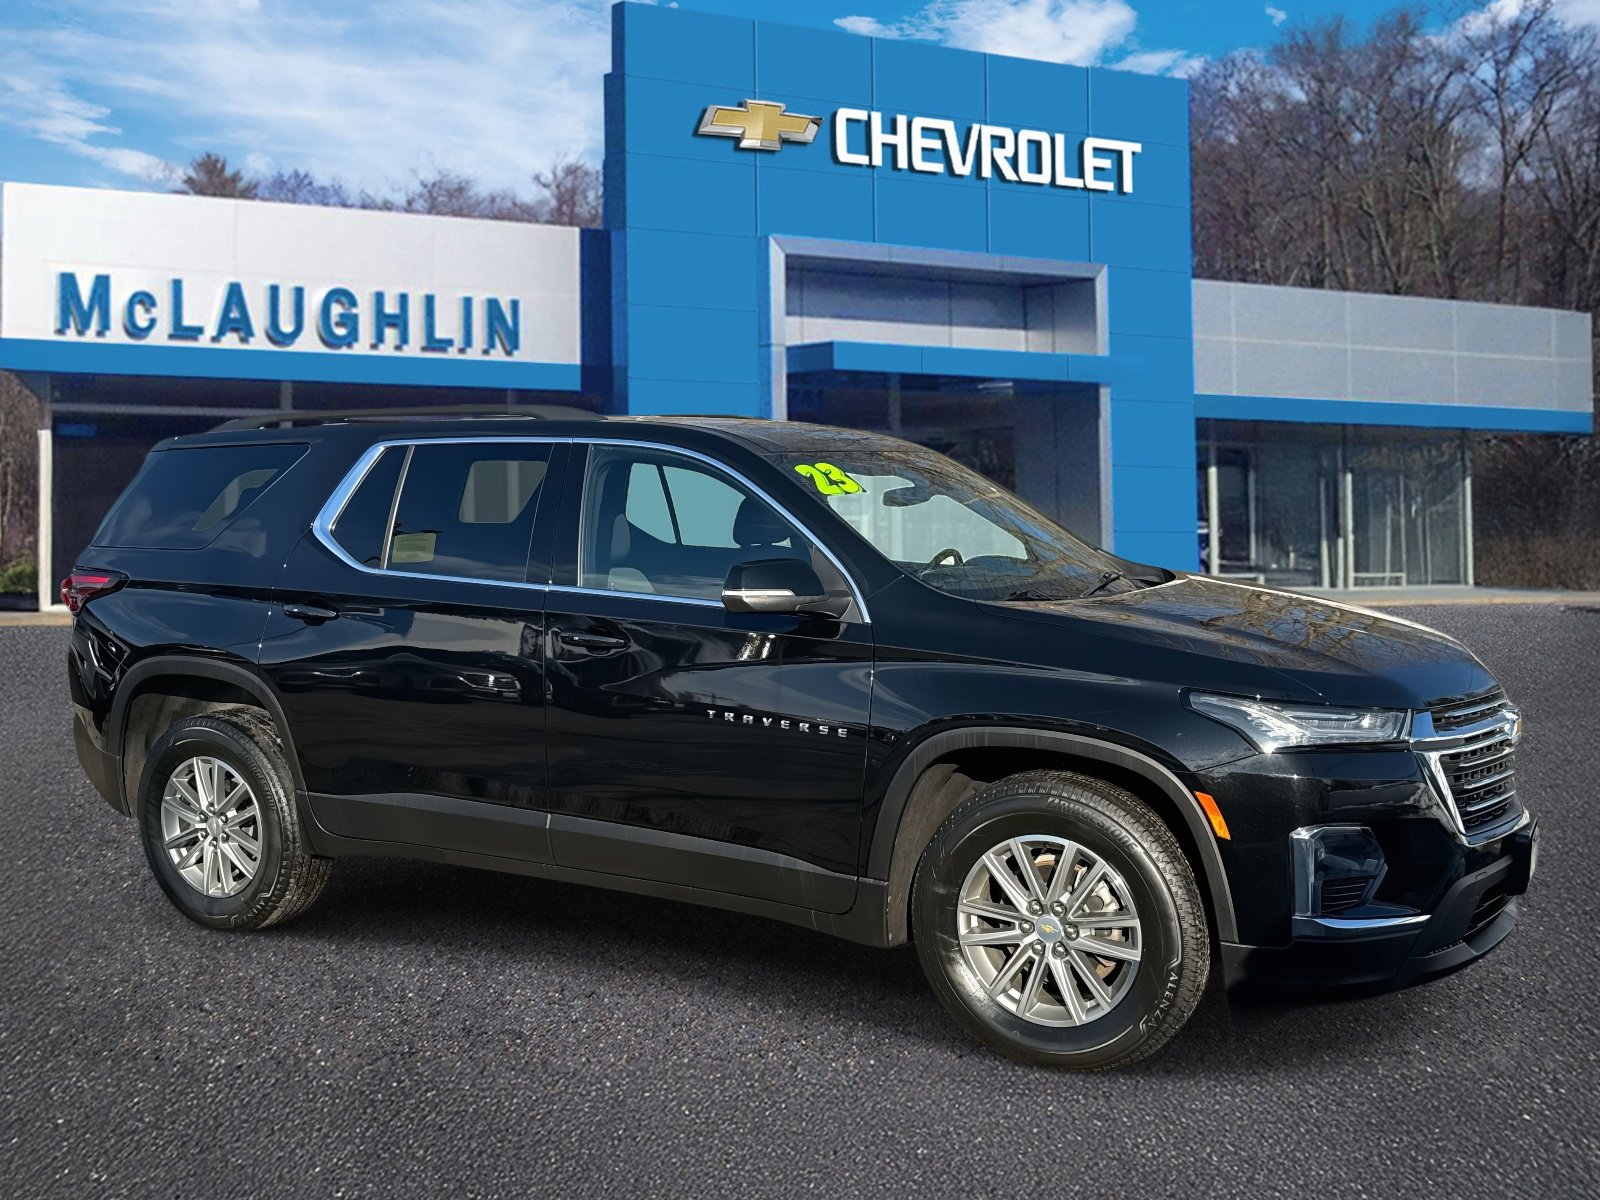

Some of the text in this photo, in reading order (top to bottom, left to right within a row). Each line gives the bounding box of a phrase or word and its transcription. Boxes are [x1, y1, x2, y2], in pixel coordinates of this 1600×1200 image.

[835, 107, 1142, 193] CHEVROLET
[57, 271, 519, 356] McLAUGHLIN
[794, 462, 863, 495] 23
[707, 709, 848, 738] TRAVERSE
[1147, 971, 1179, 1027] ALENZA
